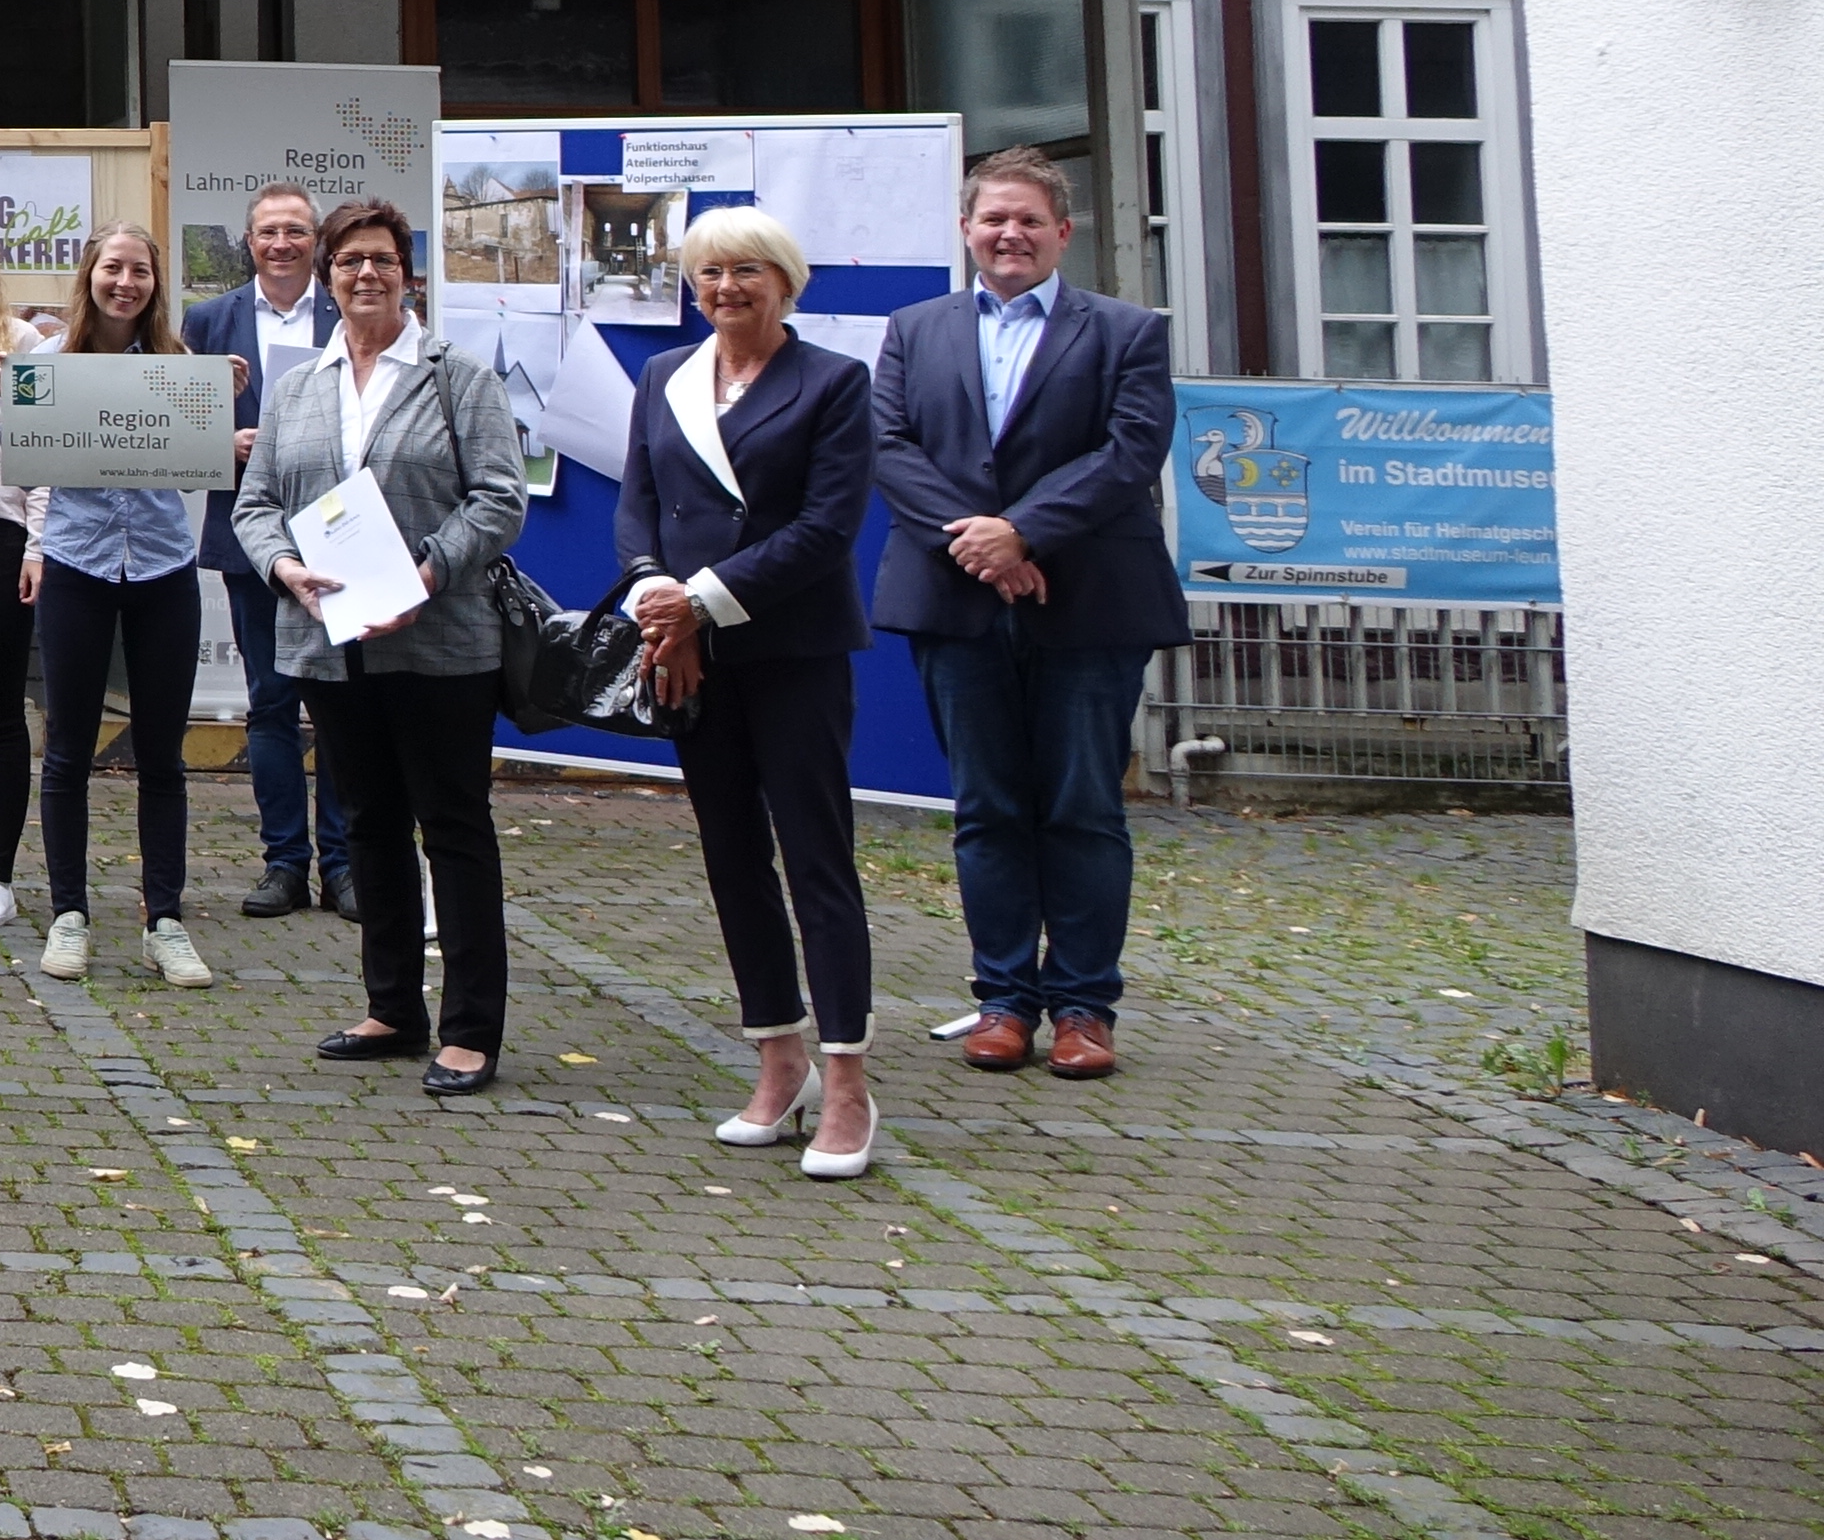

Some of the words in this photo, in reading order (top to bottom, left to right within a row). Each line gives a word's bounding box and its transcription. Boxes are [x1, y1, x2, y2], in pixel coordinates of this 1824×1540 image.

[625, 142, 708, 152] Funktionshaus
[285, 148, 365, 173] Region
[625, 157, 699, 167] Atelierkirche
[185, 172, 365, 194] Lahn-Dietzlar
[625, 173, 715, 185] Volpertshausen
[5, 205, 82, 254] Café
[99, 410, 170, 431] Region
[1336, 408, 1552, 444] Willkommen
[10, 431, 170, 450] Lahn-Dill-Wetzlar
[99, 467, 222, 478] www.lahn-dill-wetzlar.de
[1338, 459, 1375, 484] im
[1341, 520, 1398, 537] Verein
[1404, 521, 1430, 538] für
[1435, 522, 1555, 543] Heimatgesch
[1244, 565, 1278, 581] Zur
[1282, 567, 1388, 586] Spinnstube
